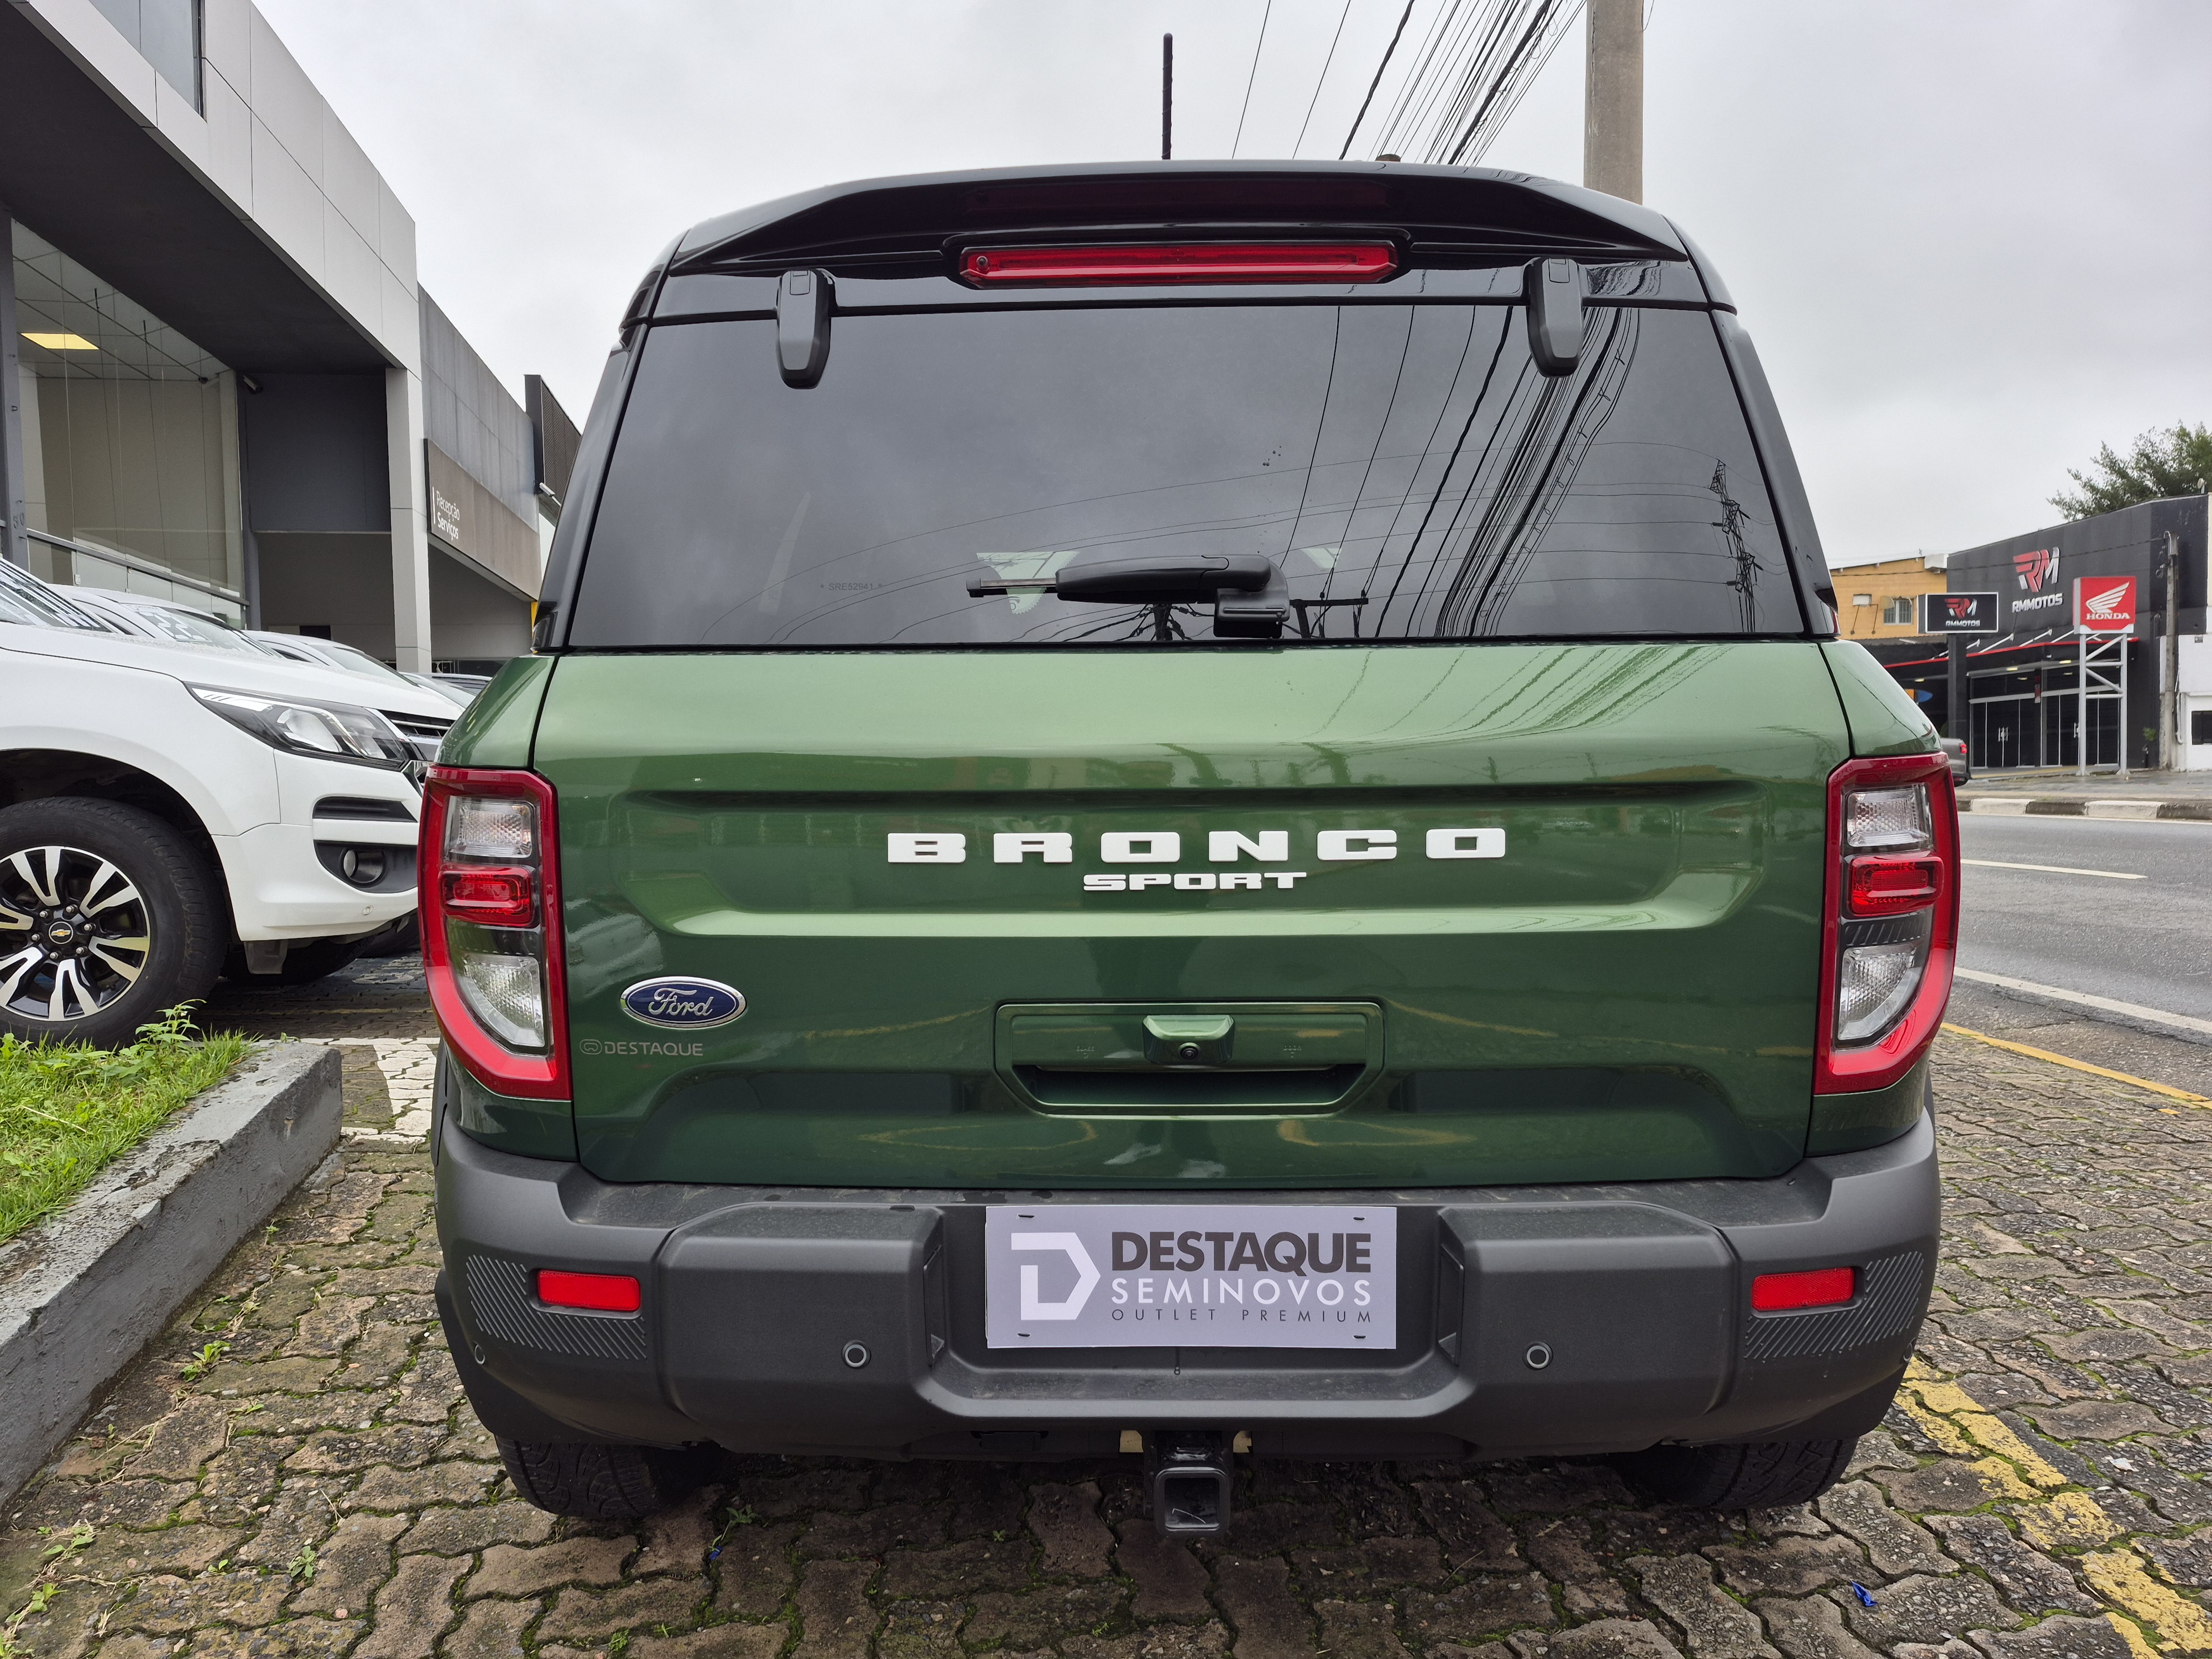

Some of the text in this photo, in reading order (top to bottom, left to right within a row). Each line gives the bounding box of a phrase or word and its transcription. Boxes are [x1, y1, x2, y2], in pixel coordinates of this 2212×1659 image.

[436, 490, 460, 521] Recepção
[437, 511, 459, 541] Serviços
[828, 583, 873, 591] SRE52941
[2011, 592, 2063, 613] RMMOTOS
[2086, 612, 2131, 620] HONDA
[887, 827, 1506, 864] BRONCO
[1083, 872, 1307, 891] SPORT
[648, 988, 714, 1016] Ford
[604, 1041, 703, 1057] DESTAQUE
[1112, 1230, 1371, 1276] DESTAQUE
[1111, 1277, 1371, 1306] SEMINOVOS
[1112, 1308, 1371, 1323] OUTLET PREMIUM
